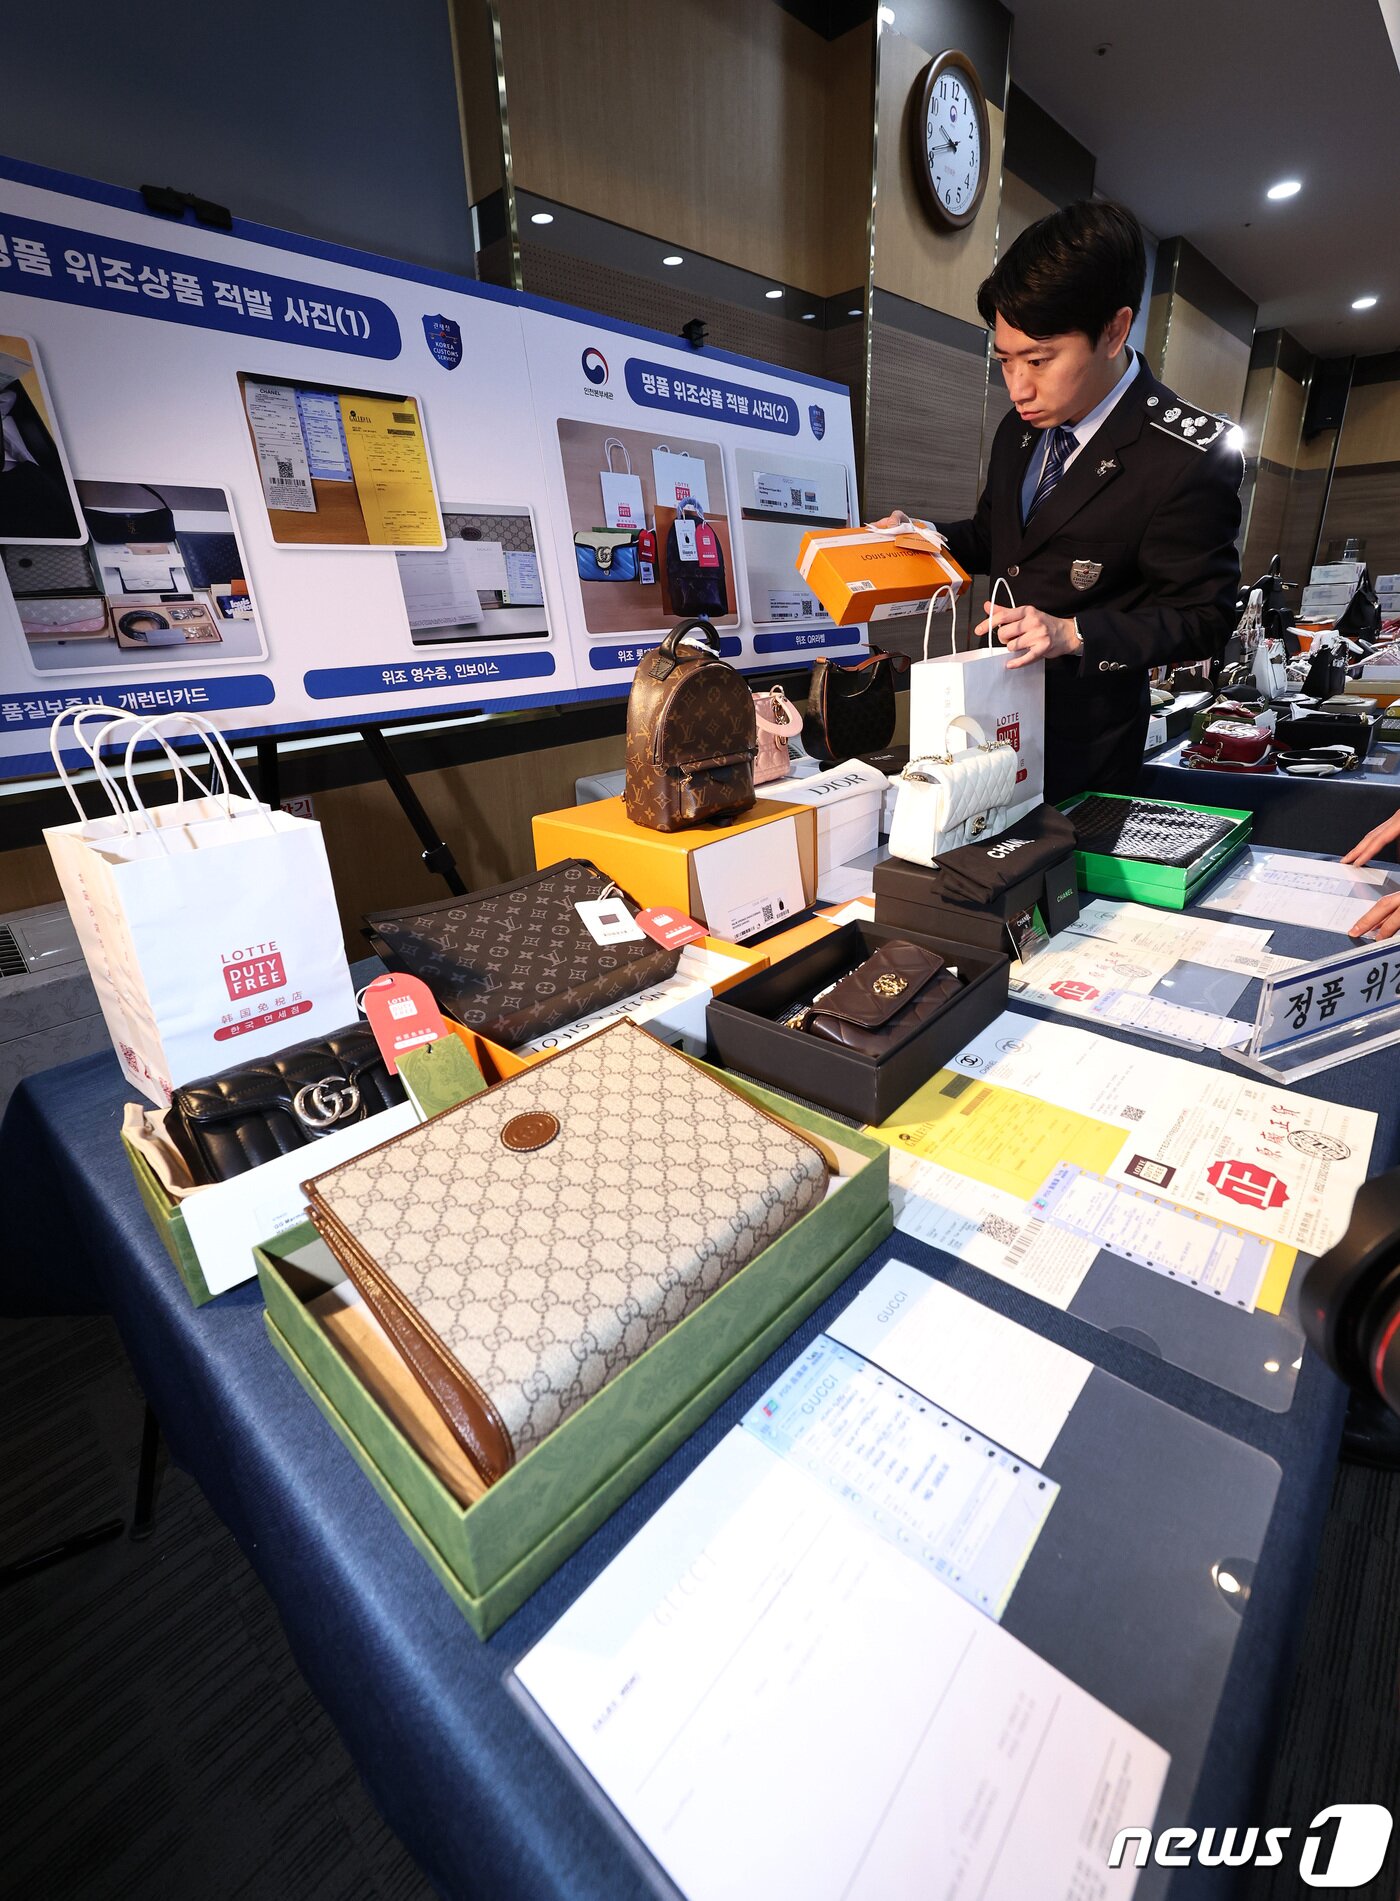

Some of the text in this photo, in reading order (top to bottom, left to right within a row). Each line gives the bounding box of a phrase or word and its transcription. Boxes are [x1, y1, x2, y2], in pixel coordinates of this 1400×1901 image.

[939, 80, 948, 101] 11
[951, 80, 960, 102] 12
[930, 96, 940, 117] 10
[962, 97, 968, 116] 1
[927, 121, 934, 140] 9
[968, 121, 974, 140] 2
[968, 150, 975, 168] 3
[935, 176, 942, 194] 7
[963, 172, 970, 190] 4
[945, 187, 952, 205] 6
[955, 187, 962, 204] 5
[64, 249, 205, 307] 위조상품
[212, 280, 274, 321] 적발
[284, 296, 371, 340] 사진(1)
[433, 347, 459, 358] CUSTOMS
[435, 341, 455, 351] KOREA
[437, 354, 457, 363] SERVICE
[259, 388, 281, 396] CHANEL
[641, 372, 789, 424] 명품 위조상품 적발 사진(2)
[860, 552, 886, 561] LOUIS
[795, 633, 826, 645] 위조 QR라벨
[617, 650, 635, 662] 위조
[381, 662, 500, 685] 위조 영수증, 인보이스
[118, 687, 210, 710] 개런티카드
[996, 712, 1019, 727] LOTTE
[998, 728, 1018, 741] DUTY
[808, 773, 867, 796] DIOR
[1056, 888, 1074, 903] CHANEL
[1016, 913, 1032, 927] CHANEL
[220, 941, 278, 964] LOTTE
[229, 959, 277, 982] DUTY
[233, 971, 282, 994] FREE
[387, 994, 411, 1005] LOTTE
[1283, 976, 1346, 1030] 정품
[230, 1005, 300, 1035] 한국 면세점
[1132, 1159, 1147, 1176] LOTTE
[1143, 1164, 1156, 1178] DUTY
[1151, 1166, 1165, 1182] FREE
[877, 1290, 909, 1324] GUCCI
[801, 1374, 840, 1416] GUCCI
